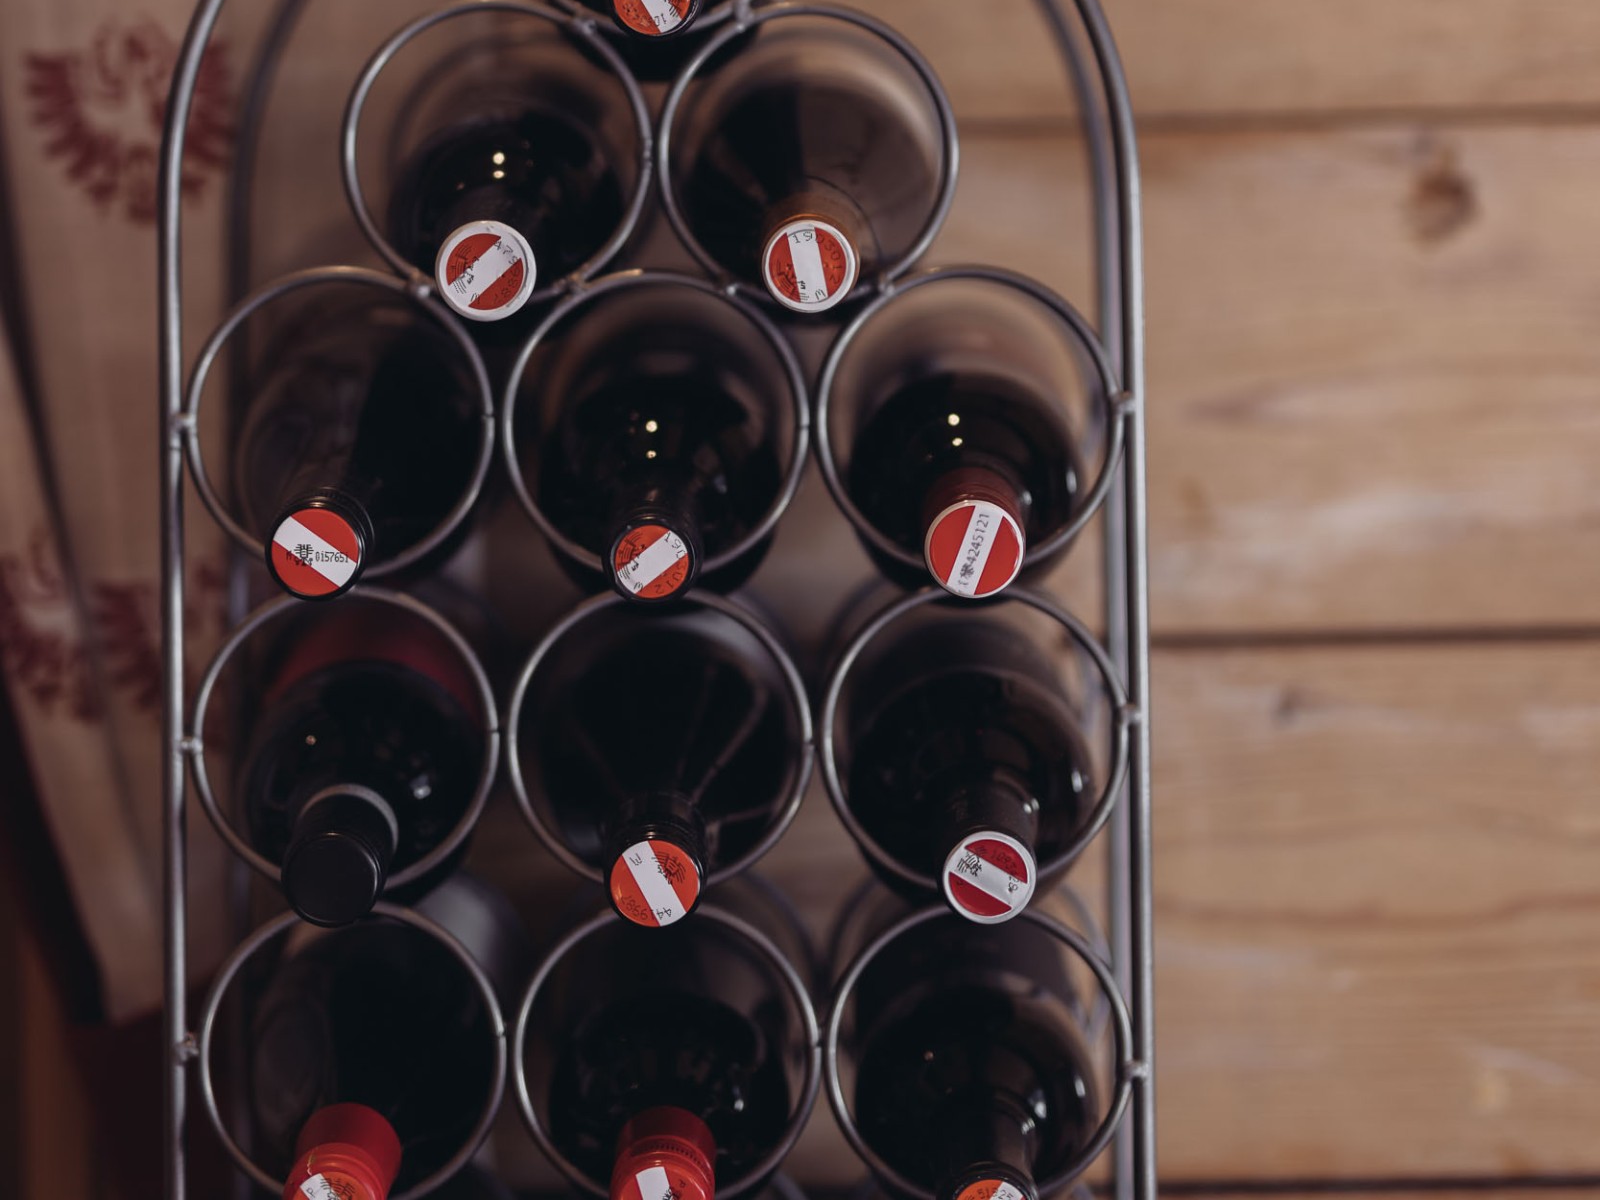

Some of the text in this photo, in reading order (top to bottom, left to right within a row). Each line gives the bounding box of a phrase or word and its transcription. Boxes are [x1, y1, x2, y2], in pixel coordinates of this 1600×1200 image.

[965, 513, 990, 568] 4245121
[314, 551, 349, 563] 0157651
[621, 893, 673, 921] 4419987
